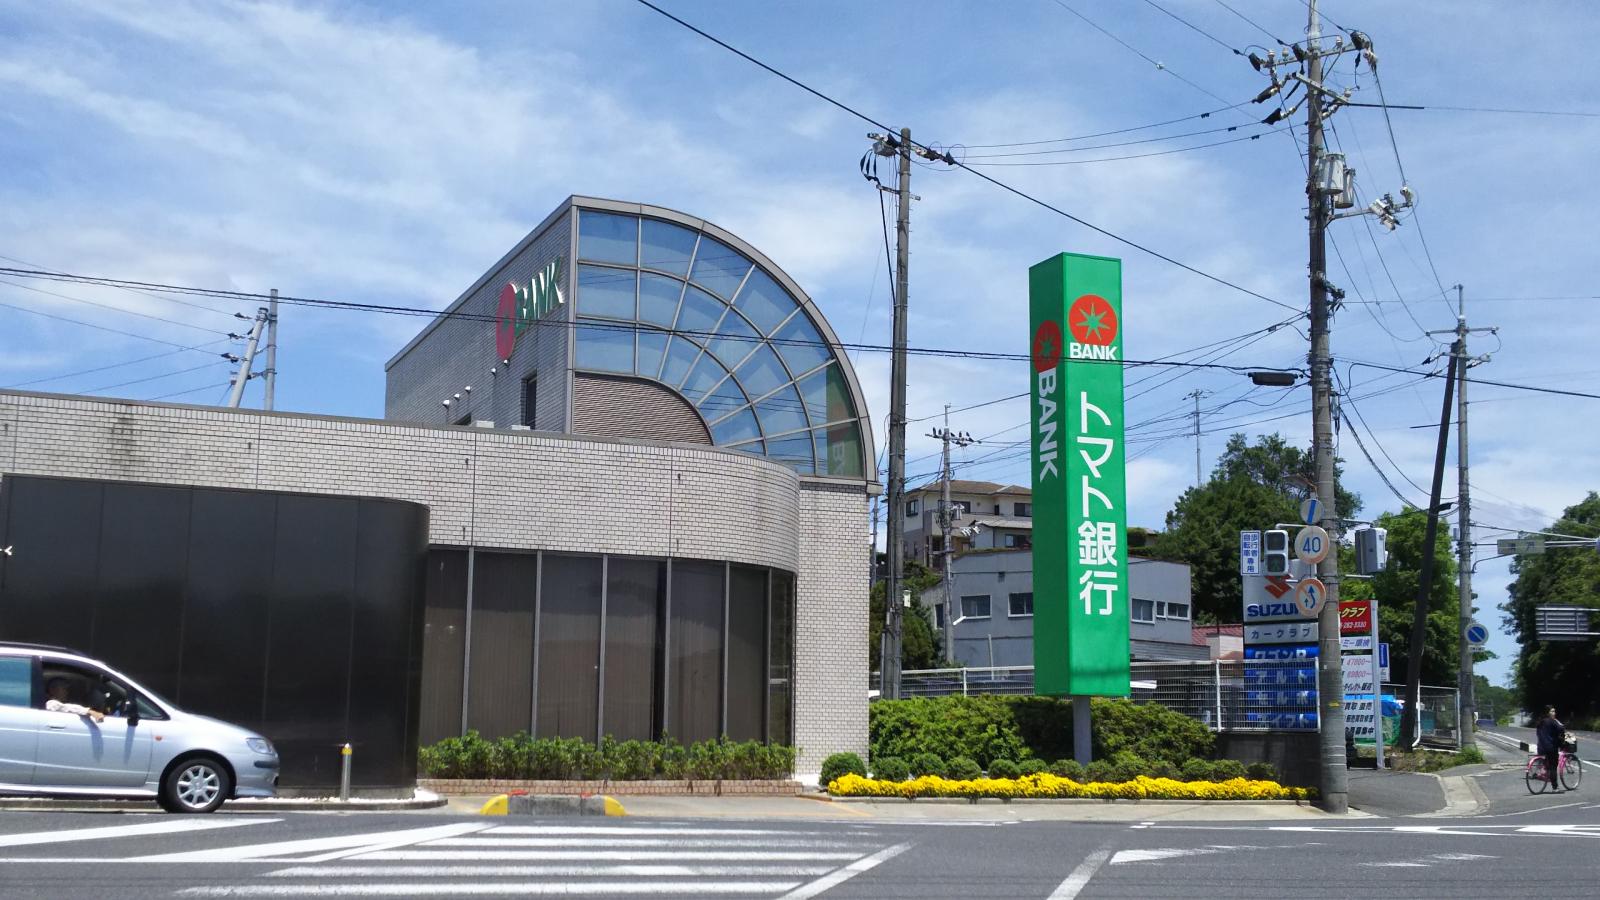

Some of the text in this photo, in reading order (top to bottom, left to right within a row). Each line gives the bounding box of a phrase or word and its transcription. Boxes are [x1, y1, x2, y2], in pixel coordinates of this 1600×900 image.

[1069, 342, 1118, 361] BANK
[1038, 367, 1059, 483] BANK
[1076, 391, 1118, 615] トマト銀行
[1302, 537, 1321, 554] 40
[1251, 627, 1311, 640] カークラブ
